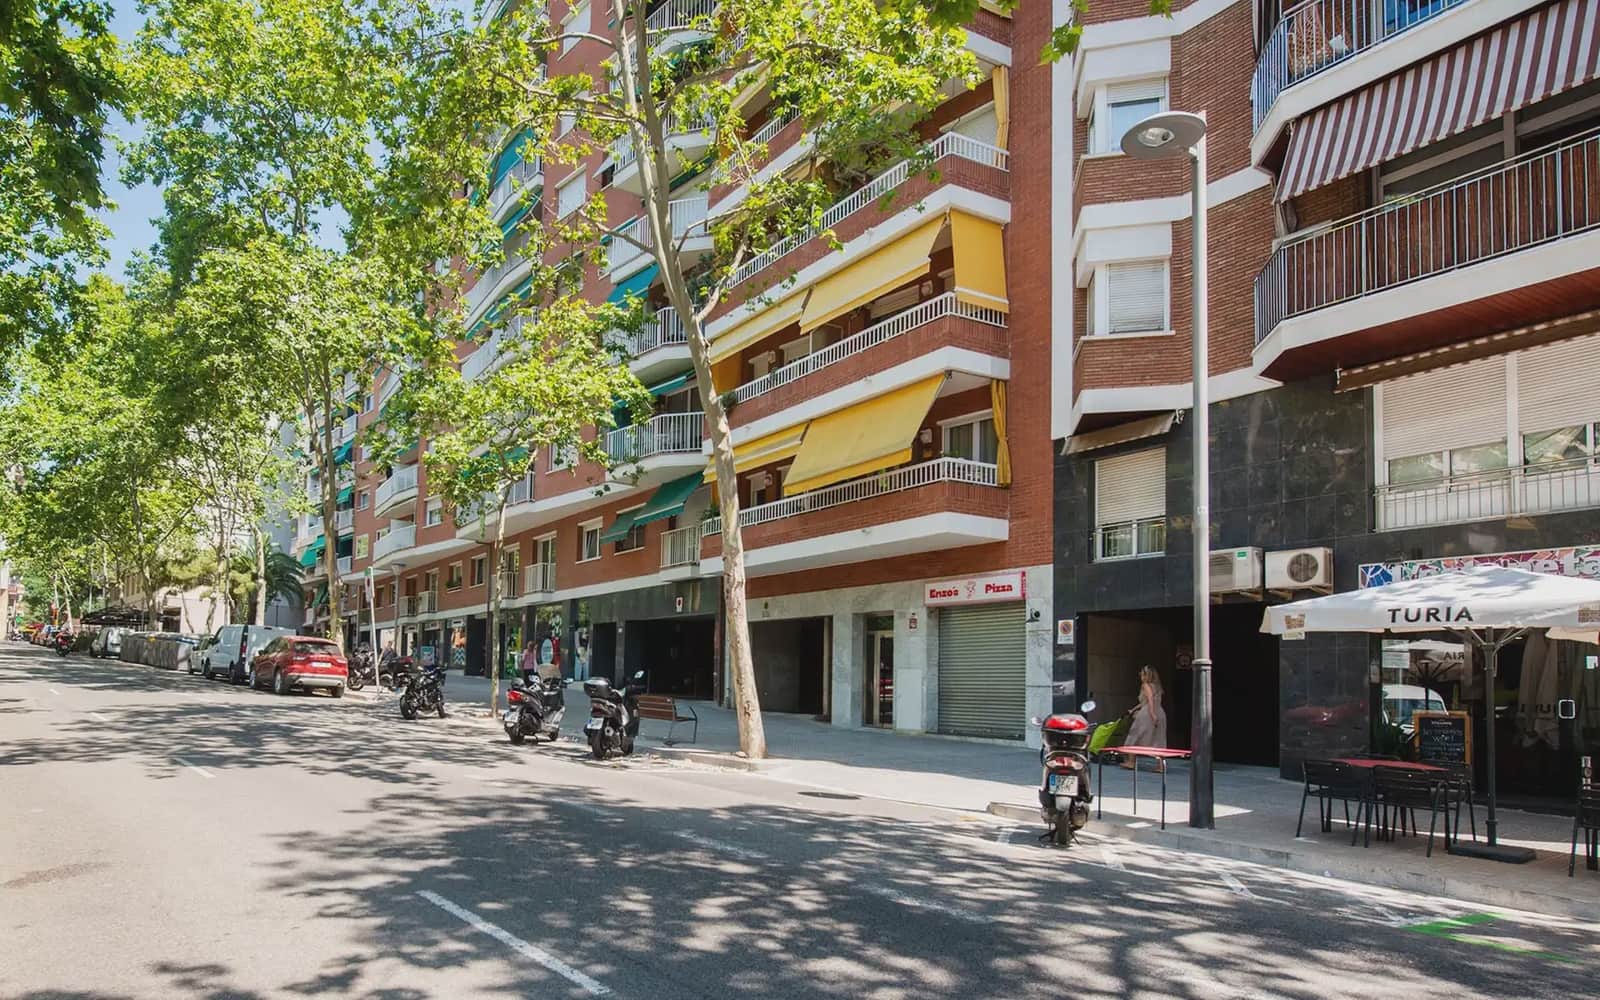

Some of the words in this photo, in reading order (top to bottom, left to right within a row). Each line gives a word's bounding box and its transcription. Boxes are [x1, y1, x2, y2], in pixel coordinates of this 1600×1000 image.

[929, 586, 959, 599] Enzo's
[985, 583, 1013, 594] Pizza
[1387, 606, 1474, 623] TURIA
